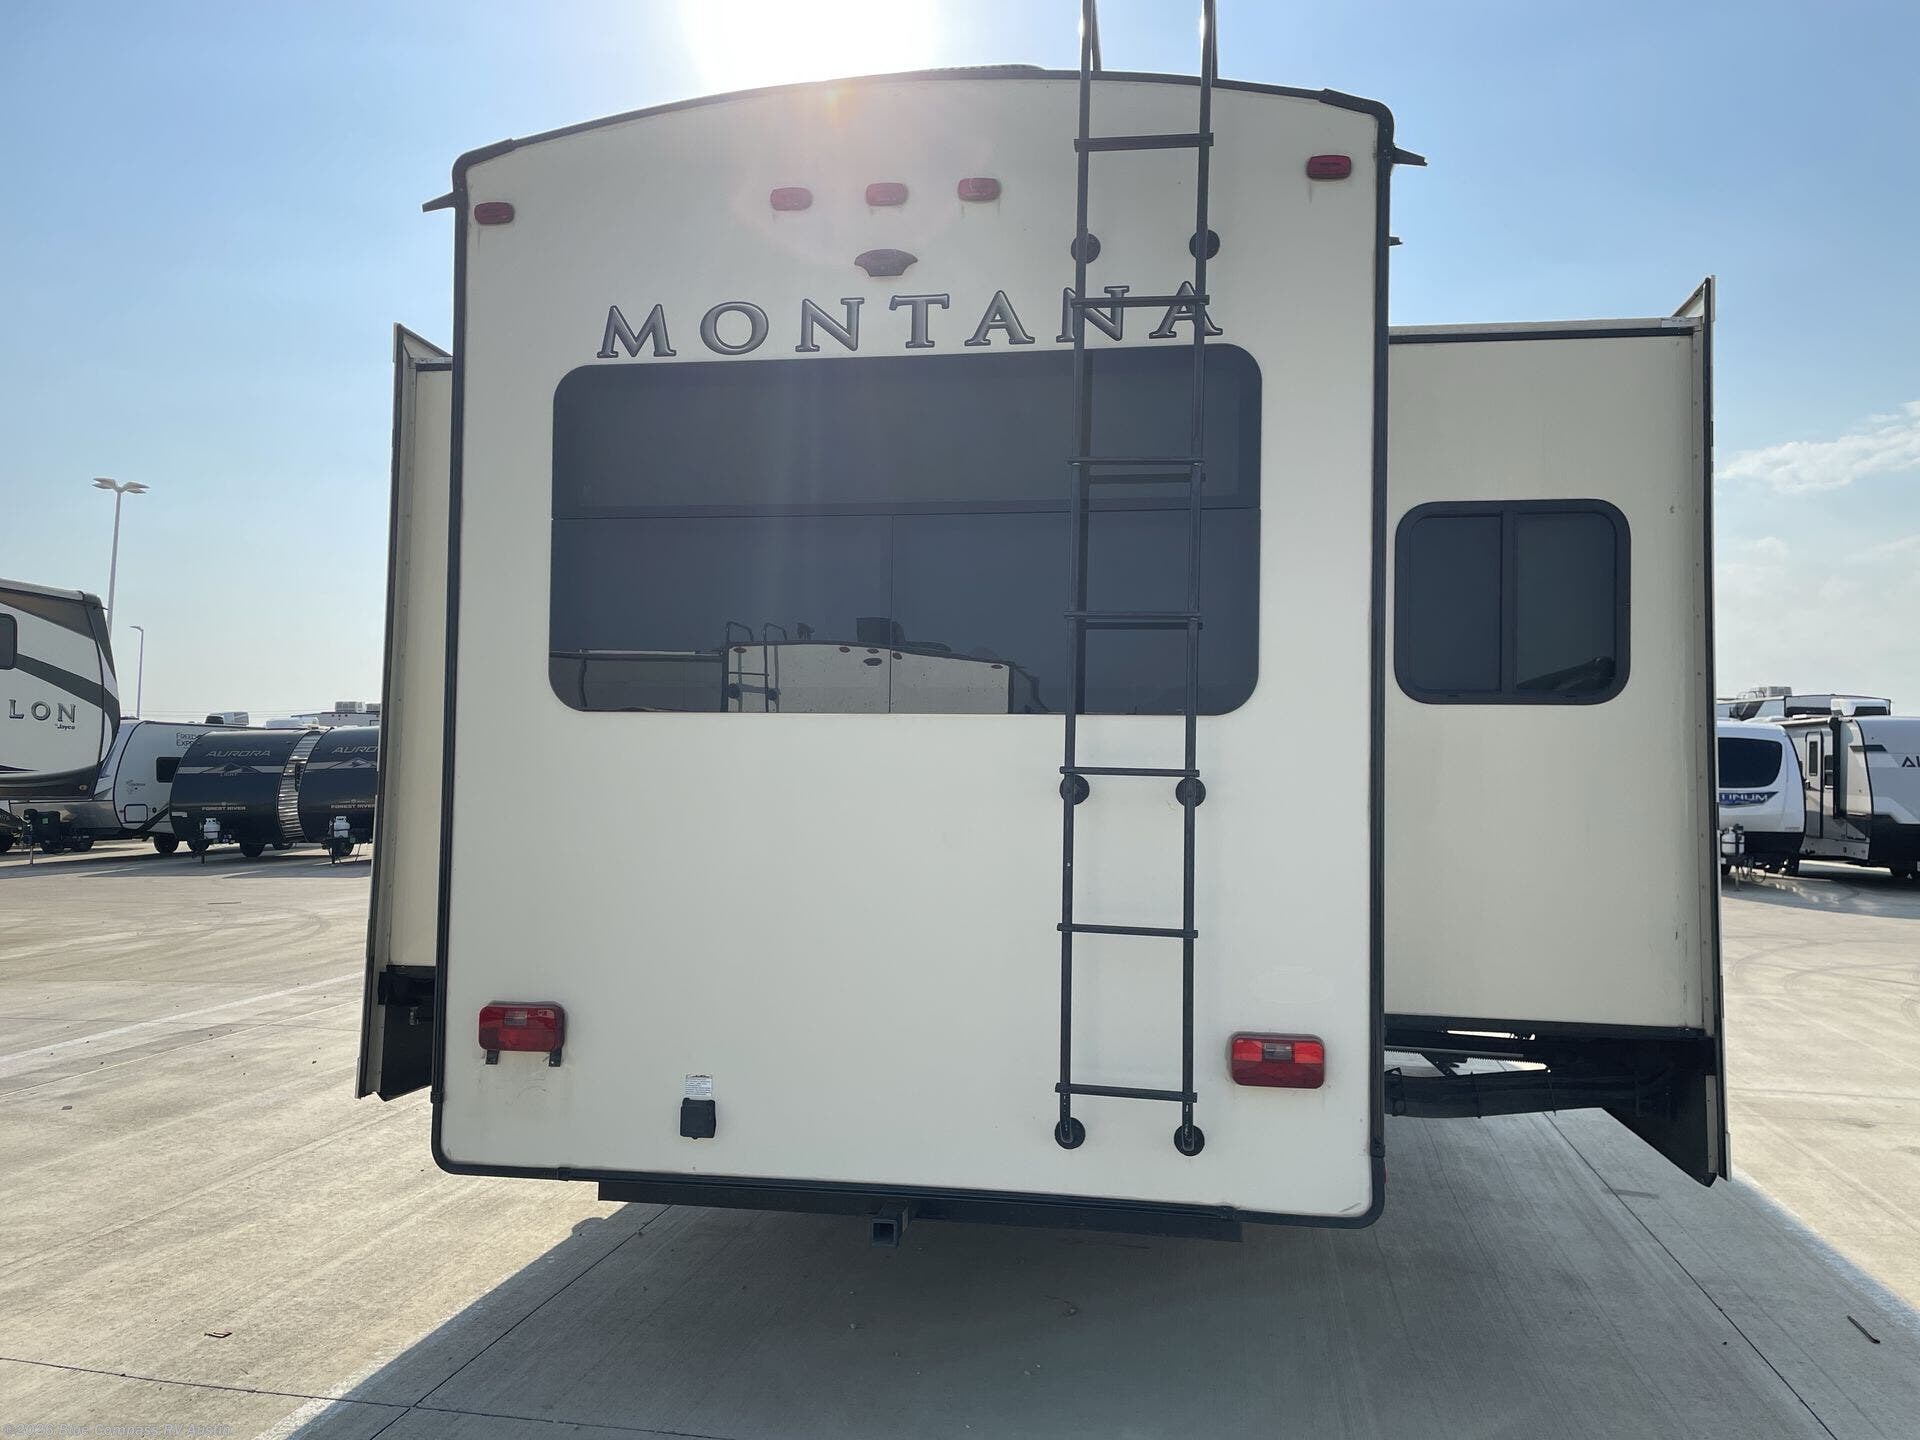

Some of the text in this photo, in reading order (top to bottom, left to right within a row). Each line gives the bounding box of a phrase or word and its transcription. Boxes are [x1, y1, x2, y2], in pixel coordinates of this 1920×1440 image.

[597, 280, 1224, 359] MONTANA
[57, 723, 76, 731] Jayco
[206, 750, 272, 758] AURORA
